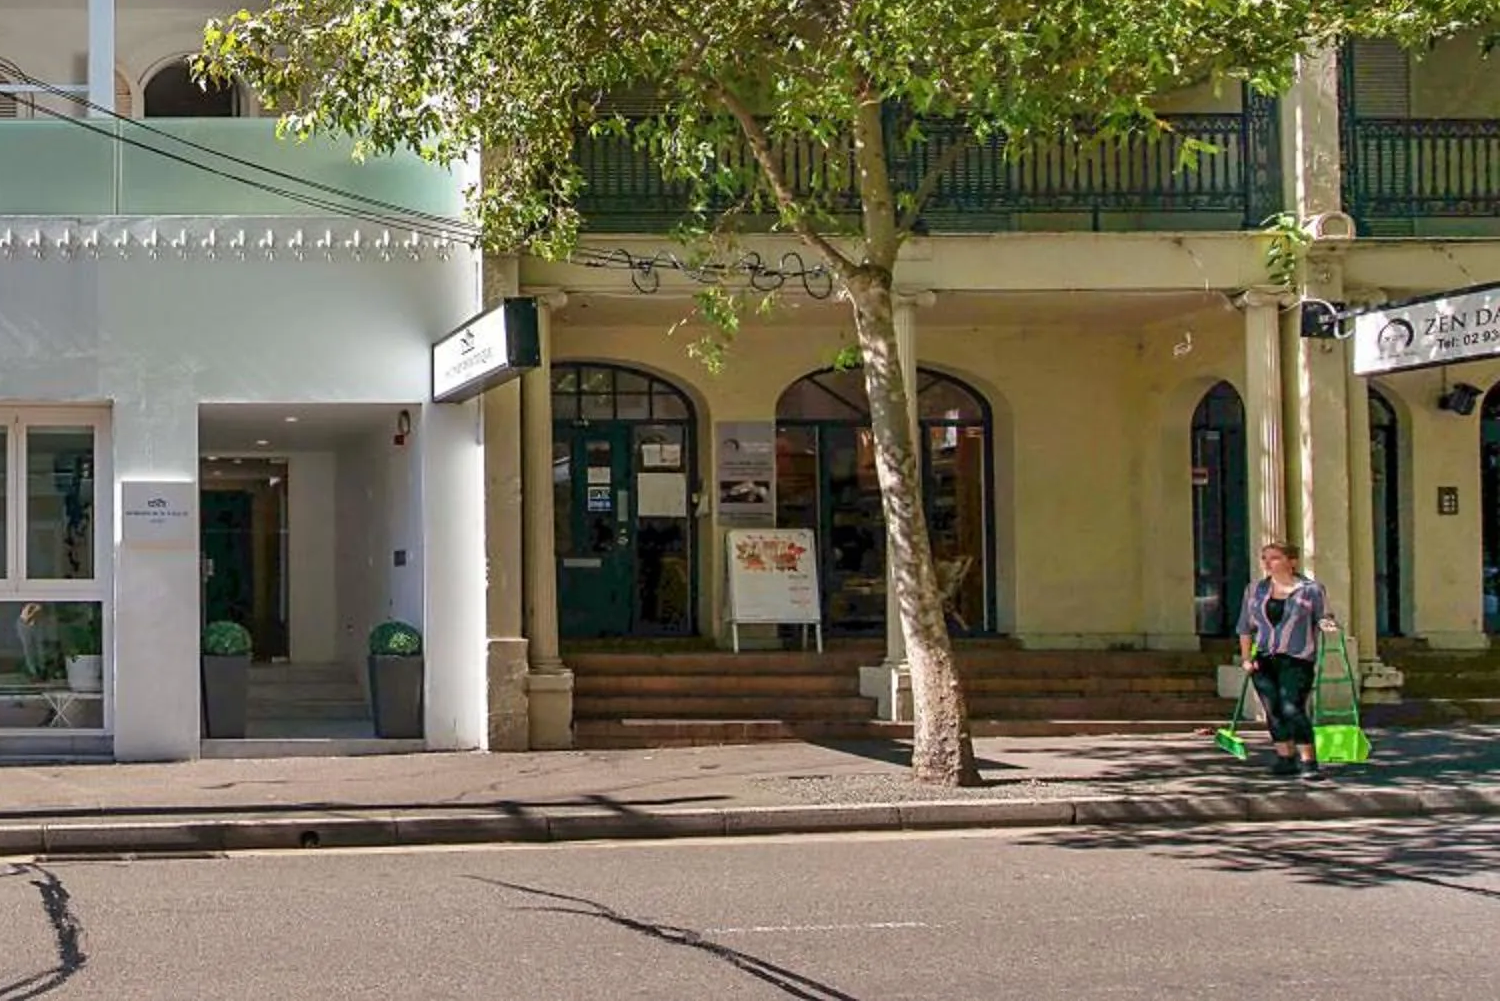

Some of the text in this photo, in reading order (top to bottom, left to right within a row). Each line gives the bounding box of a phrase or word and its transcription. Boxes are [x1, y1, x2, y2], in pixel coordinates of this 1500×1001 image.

[1424, 312, 1466, 335] ZEN
[1438, 336, 1460, 350] Tel:
[1463, 332, 1479, 346] 02
